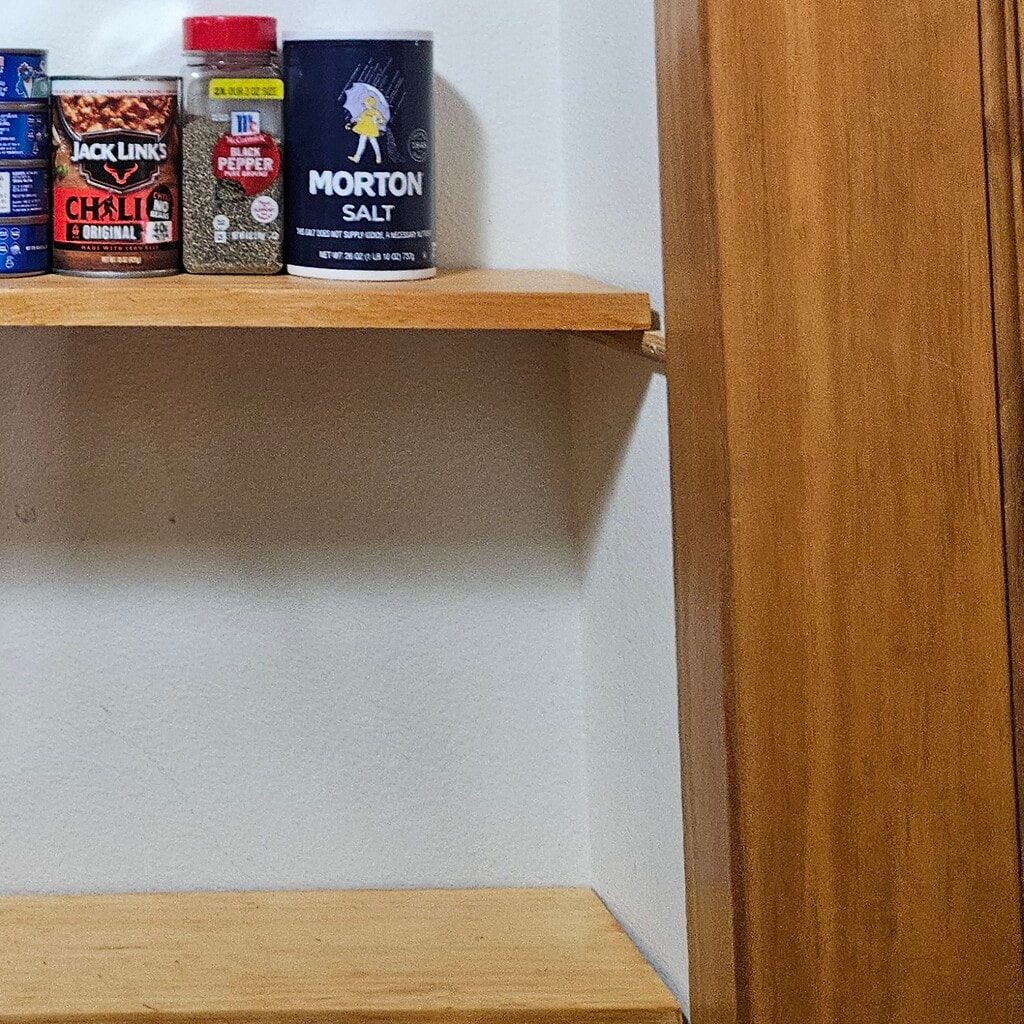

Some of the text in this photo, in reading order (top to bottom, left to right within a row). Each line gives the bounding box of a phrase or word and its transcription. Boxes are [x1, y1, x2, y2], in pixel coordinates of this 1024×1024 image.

[71, 141, 117, 162] JACK
[230, 147, 261, 156] BLACK
[217, 157, 274, 171] PEPPER
[309, 170, 422, 196] MORTON
[153, 199, 169, 212] NO
[342, 204, 395, 222] SALT
[82, 224, 136, 240] ORIGINAL
[330, 230, 343, 238] NOT
[343, 230, 364, 238] SUPPLY
[319, 250, 331, 259] NET
